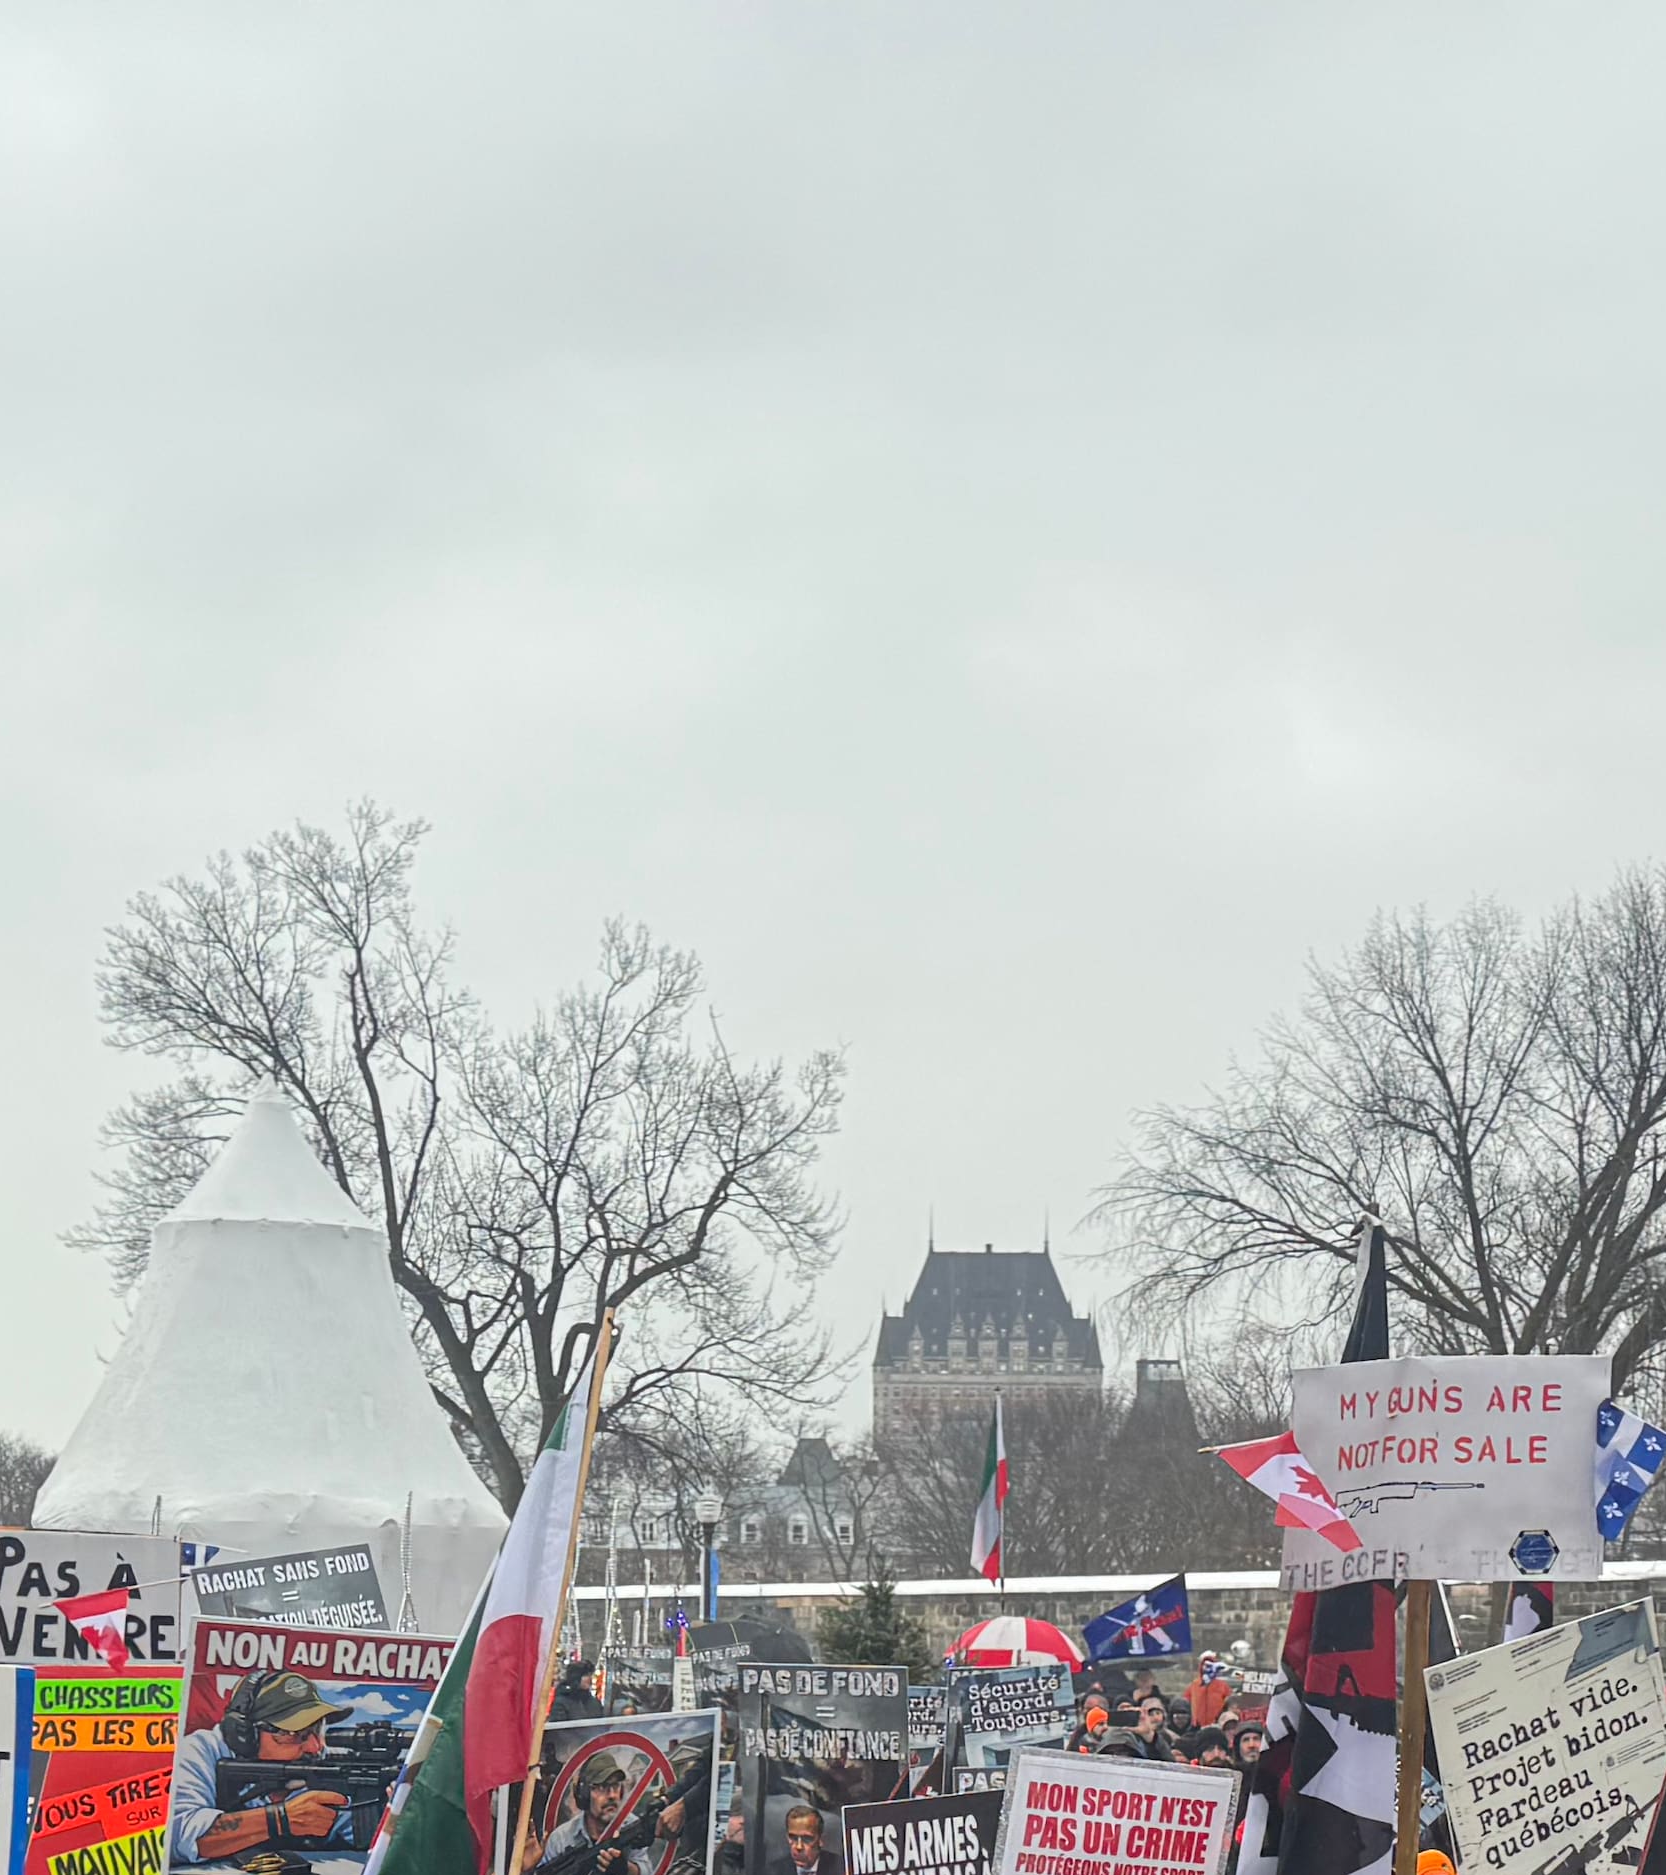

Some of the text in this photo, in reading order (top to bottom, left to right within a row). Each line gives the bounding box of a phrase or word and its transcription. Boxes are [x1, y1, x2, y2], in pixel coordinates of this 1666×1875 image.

[1339, 1383, 1563, 1421] MY GUNS ARE
[1337, 1434, 1548, 1472] NOT FOR SALE
[108, 1551, 142, 1595] À
[197, 1552, 371, 1595] RACHAT SANS FOND
[1285, 1559, 1334, 1592] THE
[205, 1630, 327, 1670] NON AU
[39, 1682, 175, 1711] CHASSEURS
[742, 1668, 900, 1698] PAS DE FOND
[968, 1674, 1059, 1700] Sécurité
[971, 1693, 1053, 1716] d'abord.
[971, 1708, 1067, 1733] Toujours.
[1460, 1677, 1639, 1770] Rachat vide.
[91, 1719, 135, 1748] LES
[802, 1728, 906, 1761] CONFIANCE.
[1468, 1711, 1649, 1804] Projet bidon.
[35, 1794, 97, 1836] VOUS
[125, 1807, 163, 1828] SUR
[1025, 1780, 1218, 1829] MON SPORT N'EST
[1476, 1768, 1594, 1838] Fardeau
[851, 1822, 899, 1875] MES
[1022, 1813, 1210, 1866] PAS UN CRIME
